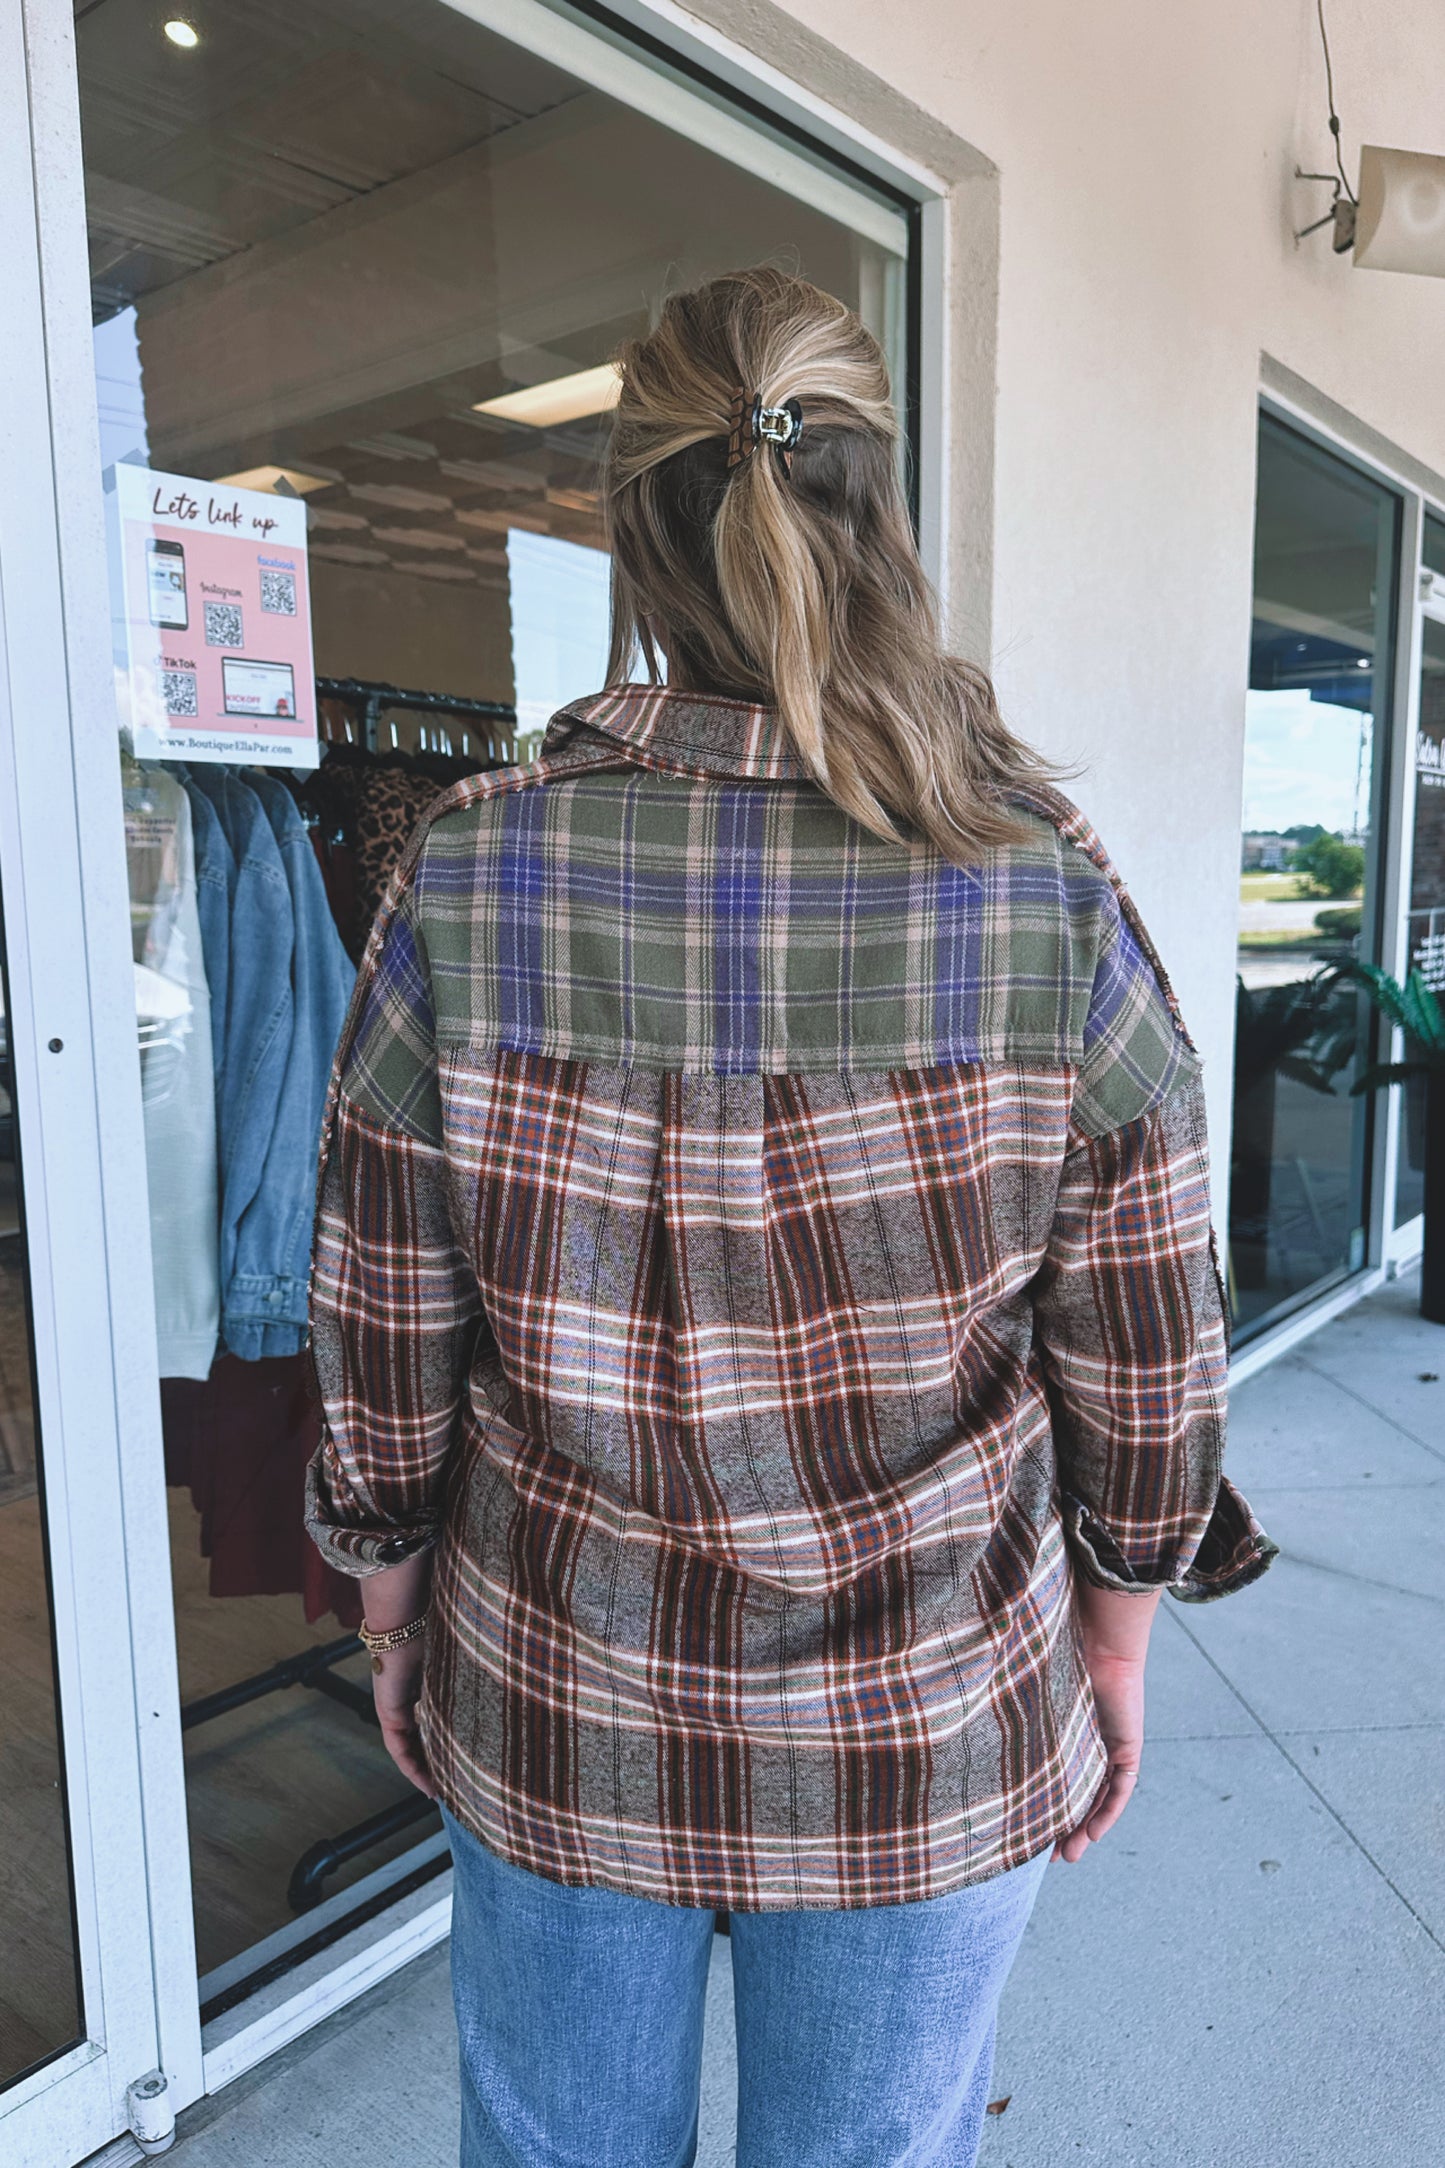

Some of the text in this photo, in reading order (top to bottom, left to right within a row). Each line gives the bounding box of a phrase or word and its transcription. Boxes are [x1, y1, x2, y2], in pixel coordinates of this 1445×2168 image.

[152, 487, 279, 539] Lets link up
[256, 554, 296, 571] facebook
[200, 581, 243, 600] Instagram
[163, 657, 197, 670] TikTok
[158, 738, 293, 755] www.BoutiqueEllaPar.com
